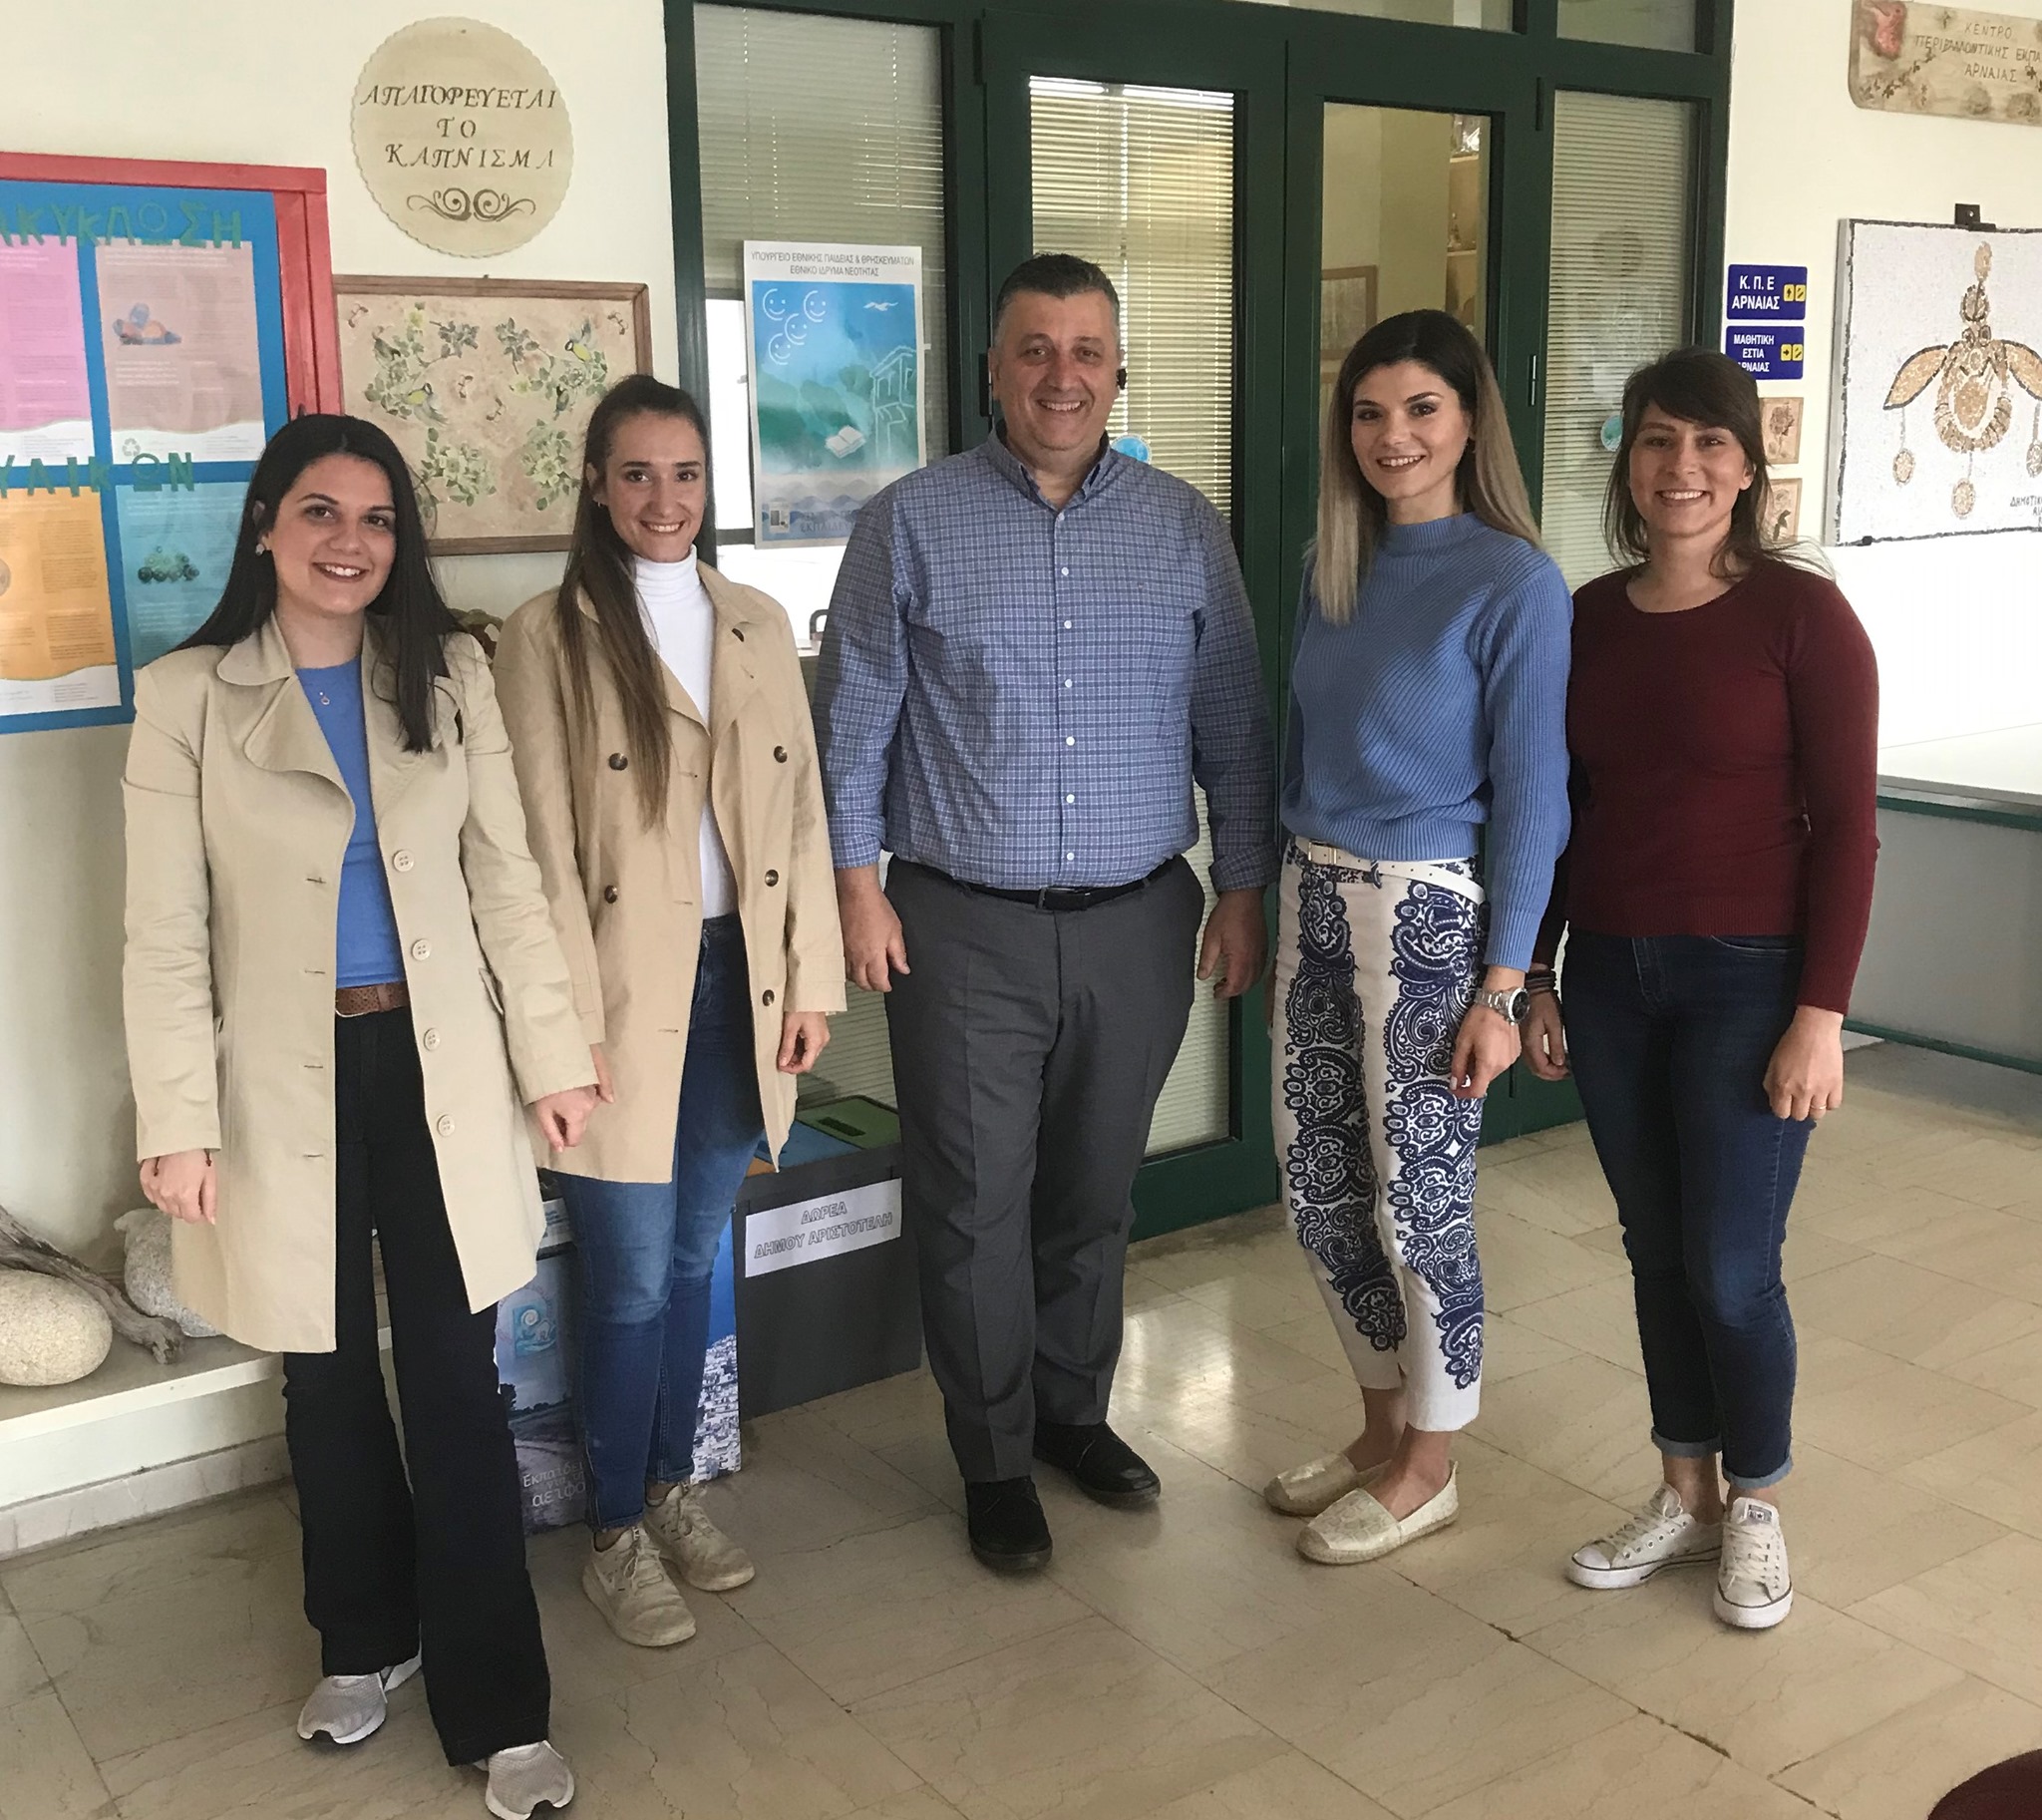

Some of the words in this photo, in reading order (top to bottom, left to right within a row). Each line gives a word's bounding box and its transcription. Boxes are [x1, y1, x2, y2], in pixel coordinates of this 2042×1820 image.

[1964, 23, 2012, 39] ΚΕΝΤΡΟ
[1964, 62, 2017, 83] ΑΡΝΑΙΑΣ
[360, 84, 556, 110] ΑΠΑΓΟΡΕΥΕΤΑΙ
[436, 117, 477, 139] ΤΟ
[385, 144, 553, 170] ΚΑΠΝΙΣΜΑ
[751, 251, 791, 261] ΥΠΟΥΡΓΕΙΟ
[792, 252, 824, 263] ΕΘΝΙΚΗΣ
[825, 254, 854, 263] ΠΑΙΔΕΙΑΣ
[861, 255, 914, 266] ΘΡΗΣΚΕΥΜΑΤΩΝ
[790, 265, 818, 274] ΕΘΝΙΚΟ
[819, 266, 844, 275] ΙΔΡΥΜΑ
[845, 267, 879, 277] ΝΕΟΤΗΤΑΣ
[1739, 275, 1751, 290] Κ.
[1754, 275, 1765, 290] Π.
[1767, 276, 1775, 290] Ε
[1732, 295, 1780, 310] ΑΡΝΑΙΑΣ
[1733, 334, 1775, 345] ΜΑΘΗΤΙΚΗ
[1742, 348, 1765, 358] ΕΣΤΙΑ
[1738, 362, 1770, 372] ΡΝΑΙΑΣ
[801, 1201, 848, 1225] ΔΩΡΕΑ
[754, 1233, 805, 1259] ΔΗΜΟΥ
[808, 1212, 893, 1245] ΑΡΙΣΤΟΤΕΛΗ
